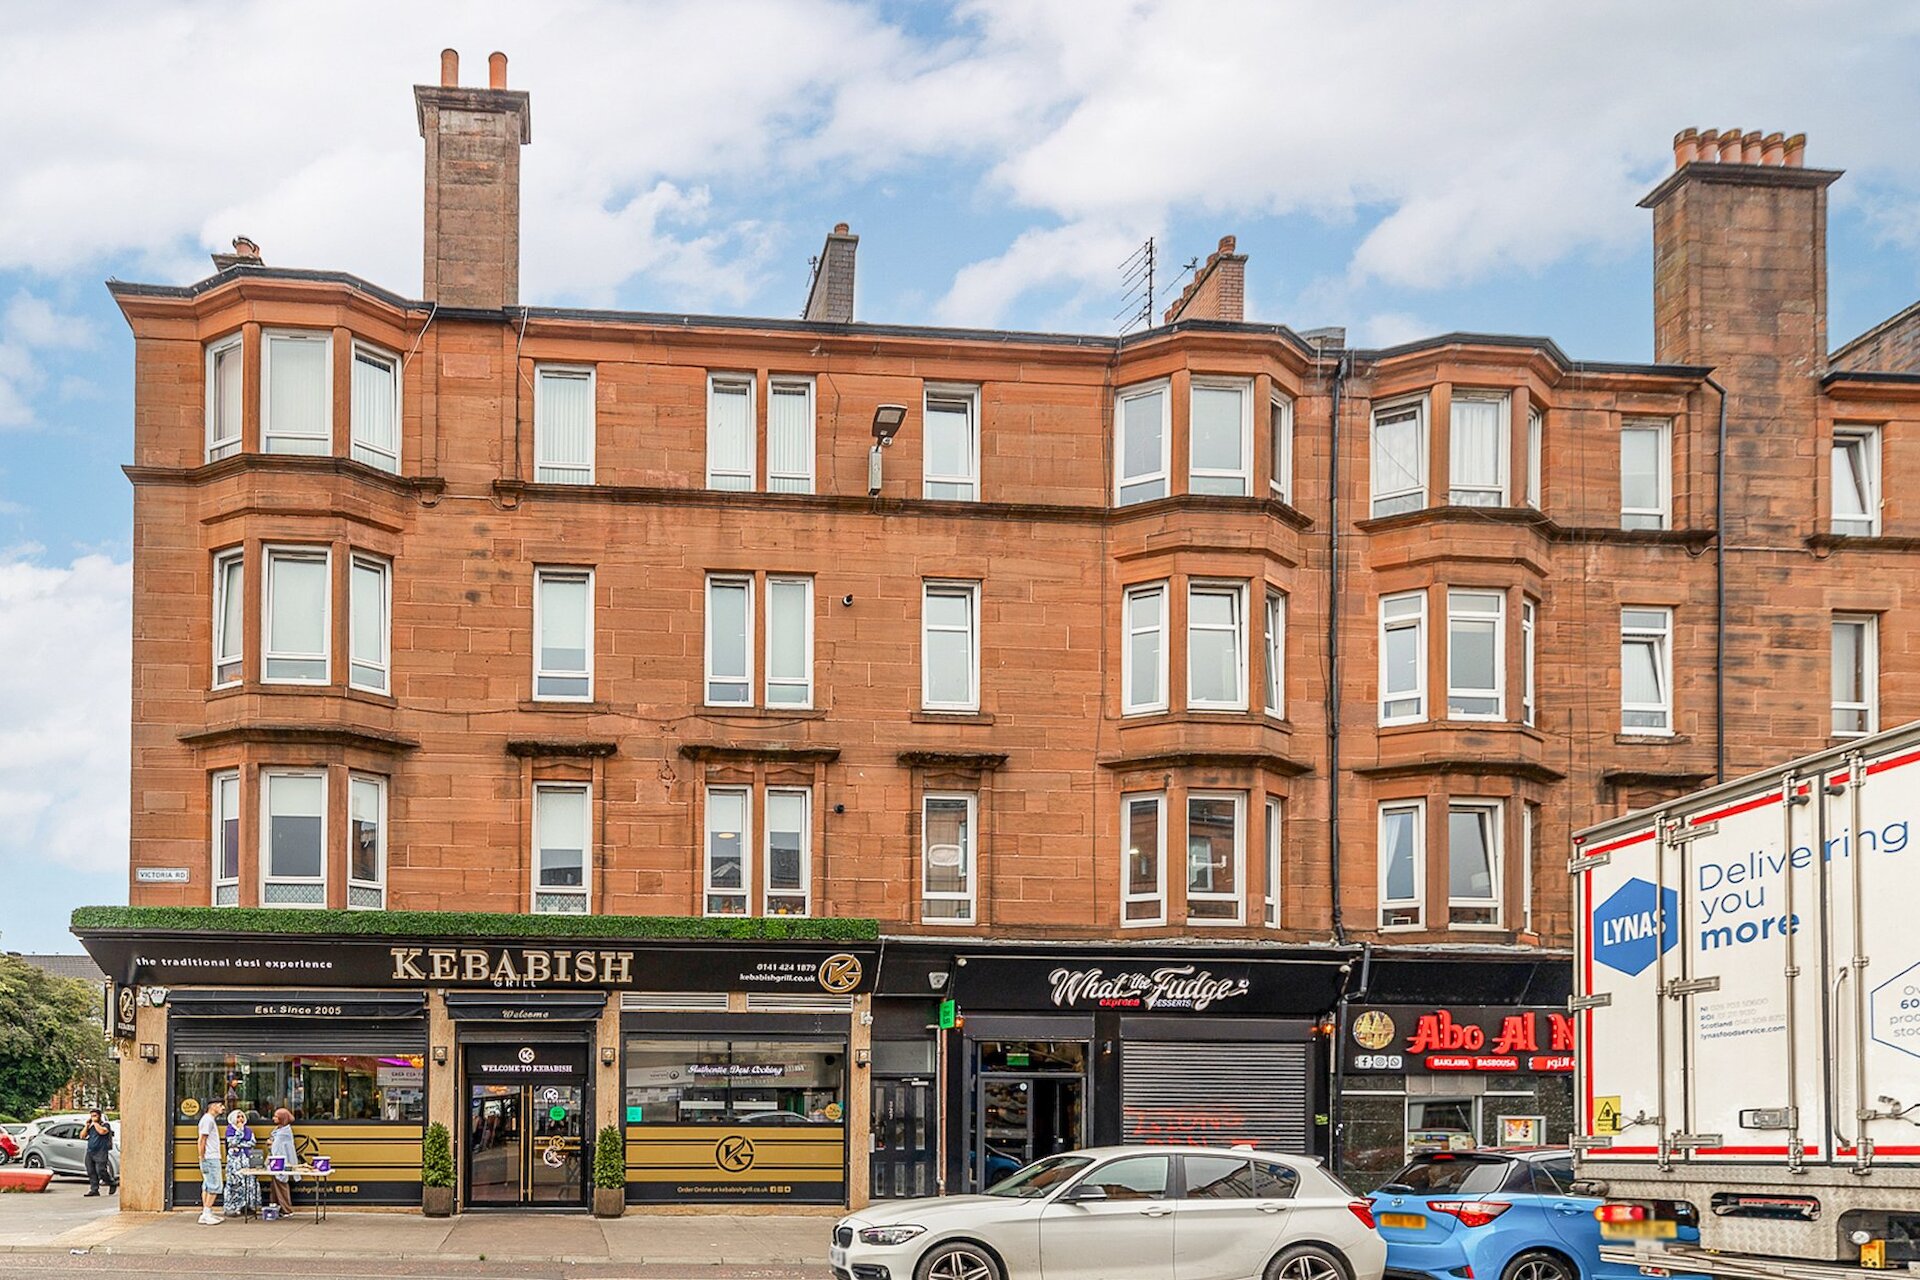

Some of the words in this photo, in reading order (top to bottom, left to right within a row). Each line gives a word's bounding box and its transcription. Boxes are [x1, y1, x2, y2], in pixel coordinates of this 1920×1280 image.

[1699, 821, 1908, 891] Delivering
[1701, 886, 1764, 924] you
[1603, 909, 1667, 946] LYNAS
[1701, 912, 1800, 951] more
[136, 956, 157, 967] the
[161, 957, 230, 968] traditional
[235, 958, 261, 968] desi
[265, 959, 333, 970] experience
[390, 947, 635, 984] KEBABISH
[756, 963, 777, 972] 0141
[778, 963, 794, 972] 424
[797, 963, 817, 972] 1879
[493, 979, 537, 988] GRILL
[739, 973, 816, 983] kebabishgrill.co.uk
[1047, 967, 1140, 1007] What
[1129, 972, 1152, 990] the
[1144, 964, 1248, 1012] Fudge
[254, 1005, 277, 1014] Est.
[279, 1005, 312, 1015] Since
[314, 1005, 342, 1015] 2005
[501, 1009, 549, 1019] Welcome
[1700, 1020, 1733, 1030] Scotland
[1405, 1009, 1485, 1054] Abo
[1491, 1010, 1539, 1055] Al
[1700, 1025, 1786, 1040] lynasfoodservice.com
[481, 1065, 521, 1073] WELCOME
[521, 1065, 532, 1073] TO
[532, 1065, 573, 1073] KEBABISH
[1433, 1058, 1471, 1067] BAKLAWA
[1476, 1058, 1517, 1067] BASBOUSA
[751, 1064, 783, 1077] Cooking
